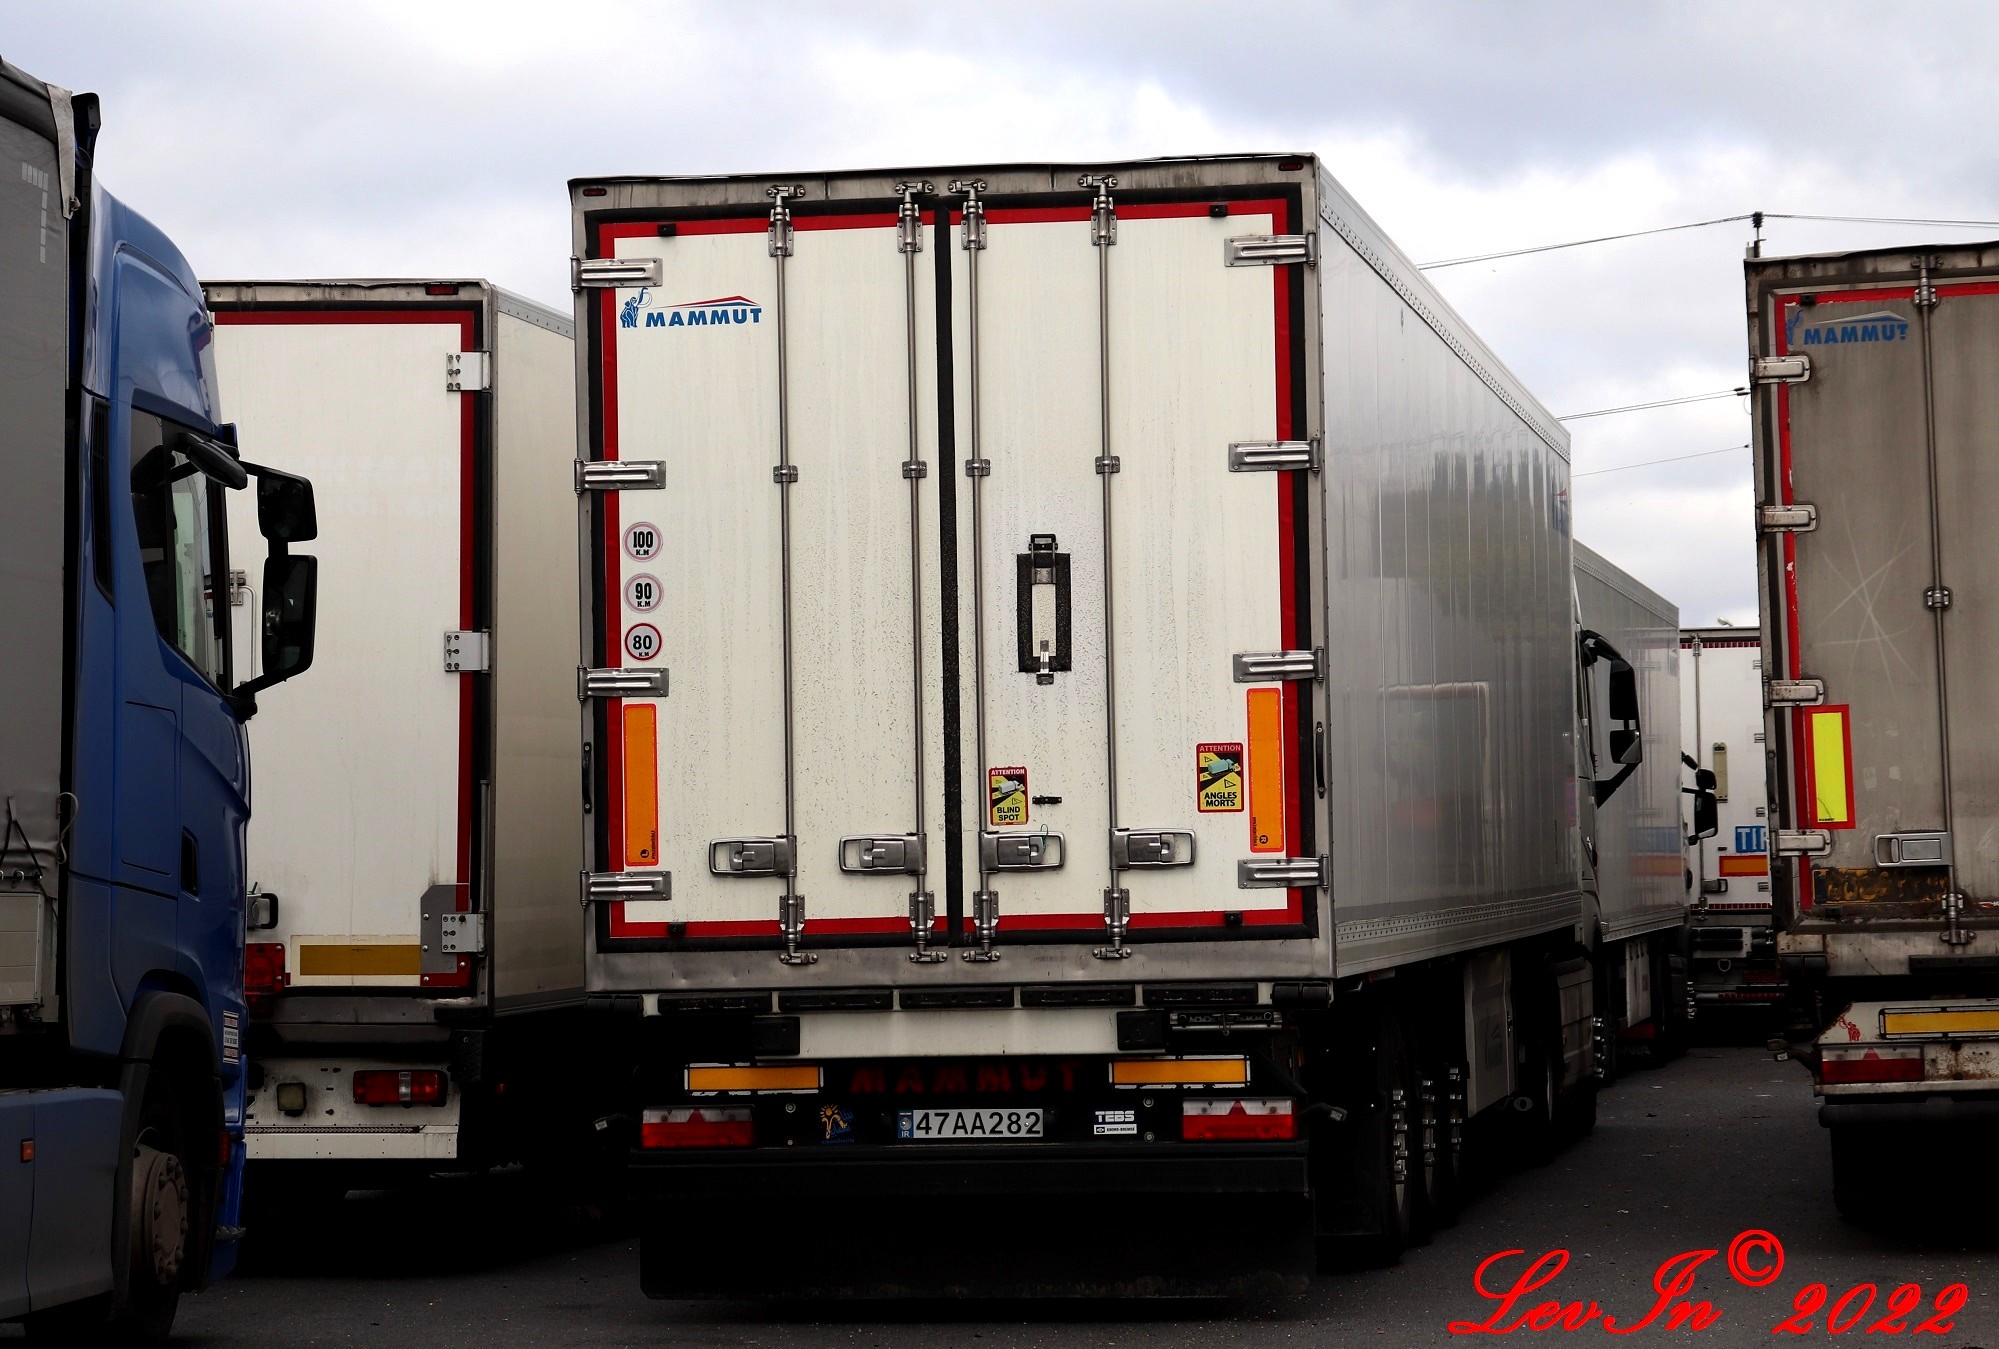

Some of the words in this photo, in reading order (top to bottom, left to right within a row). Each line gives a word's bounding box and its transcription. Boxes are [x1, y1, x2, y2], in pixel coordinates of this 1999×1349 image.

[645, 307, 762, 328] MAMMUT
[1804, 323, 1908, 345] MAMMUT
[633, 531, 653, 548] 100
[635, 582, 652, 600] 90
[632, 635, 653, 650] 80
[848, 1060, 1087, 1096] MAMMUT
[916, 1111, 1041, 1135] 47AA282
[1095, 1110, 1135, 1123] TEBS
[901, 1130, 910, 1138] IR
